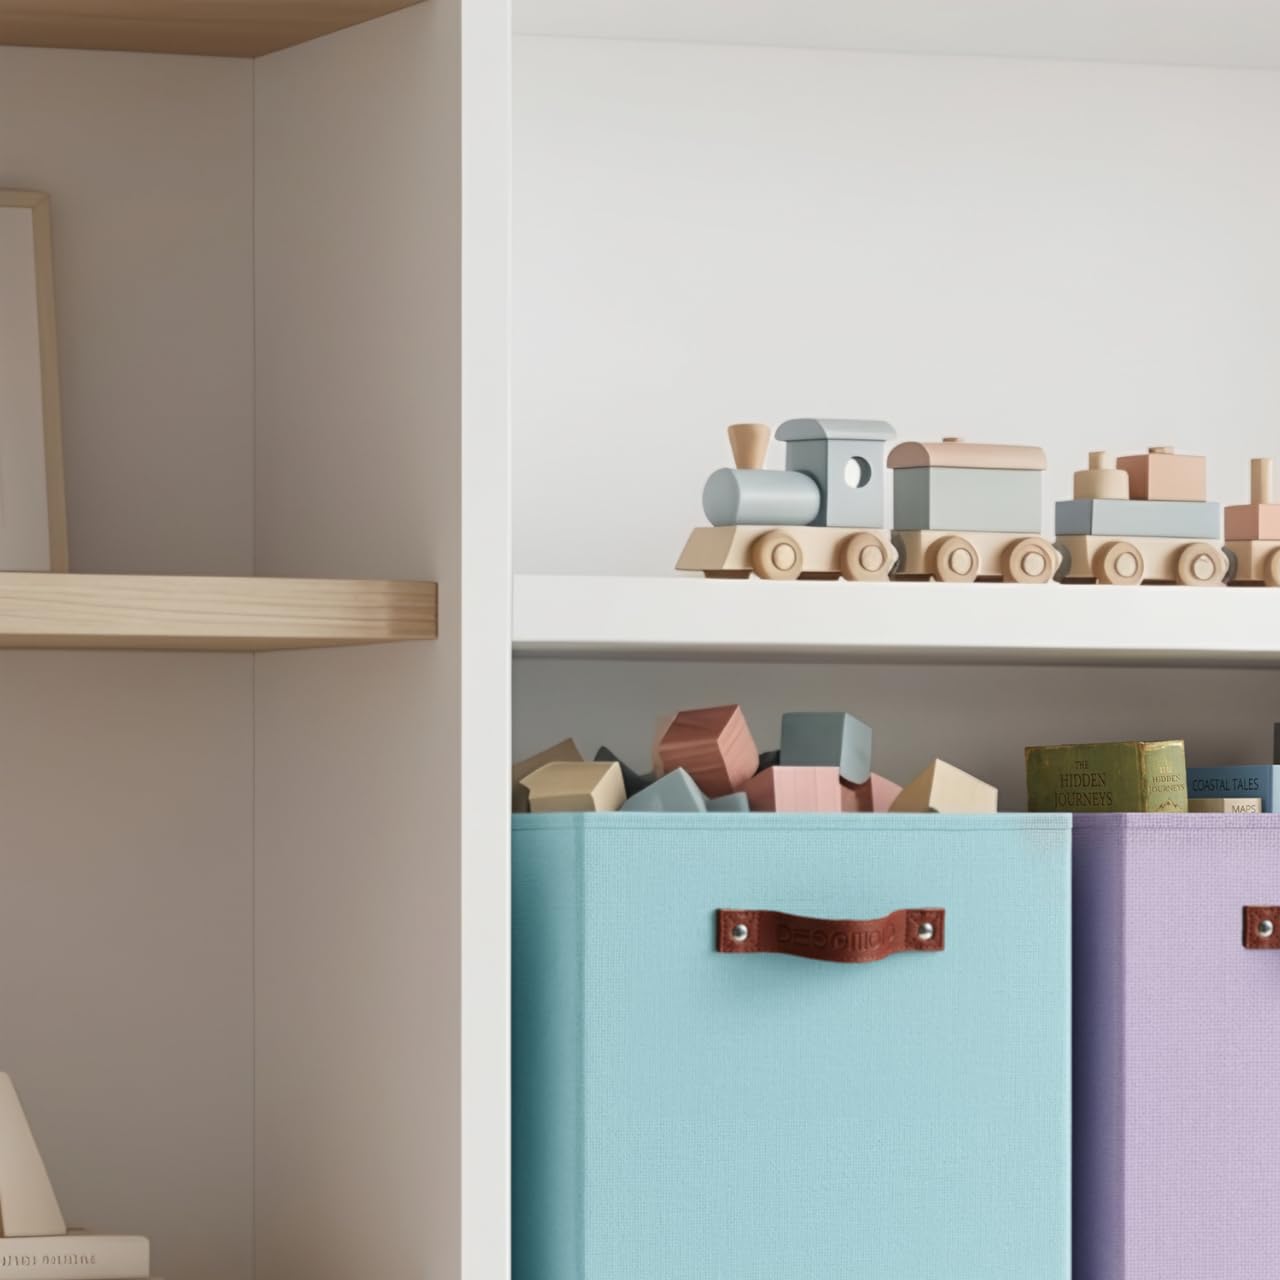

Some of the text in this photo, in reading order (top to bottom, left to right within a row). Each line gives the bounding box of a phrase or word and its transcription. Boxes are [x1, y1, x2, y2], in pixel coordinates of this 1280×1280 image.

[1074, 760, 1089, 770] THE
[1059, 772, 1106, 788] HIDDEN
[1152, 775, 1181, 783] HIDDEN
[1193, 777, 1259, 792] COASTAL TALES
[1054, 791, 1113, 808] JOURNEYS
[1231, 804, 1256, 813] MAPS
